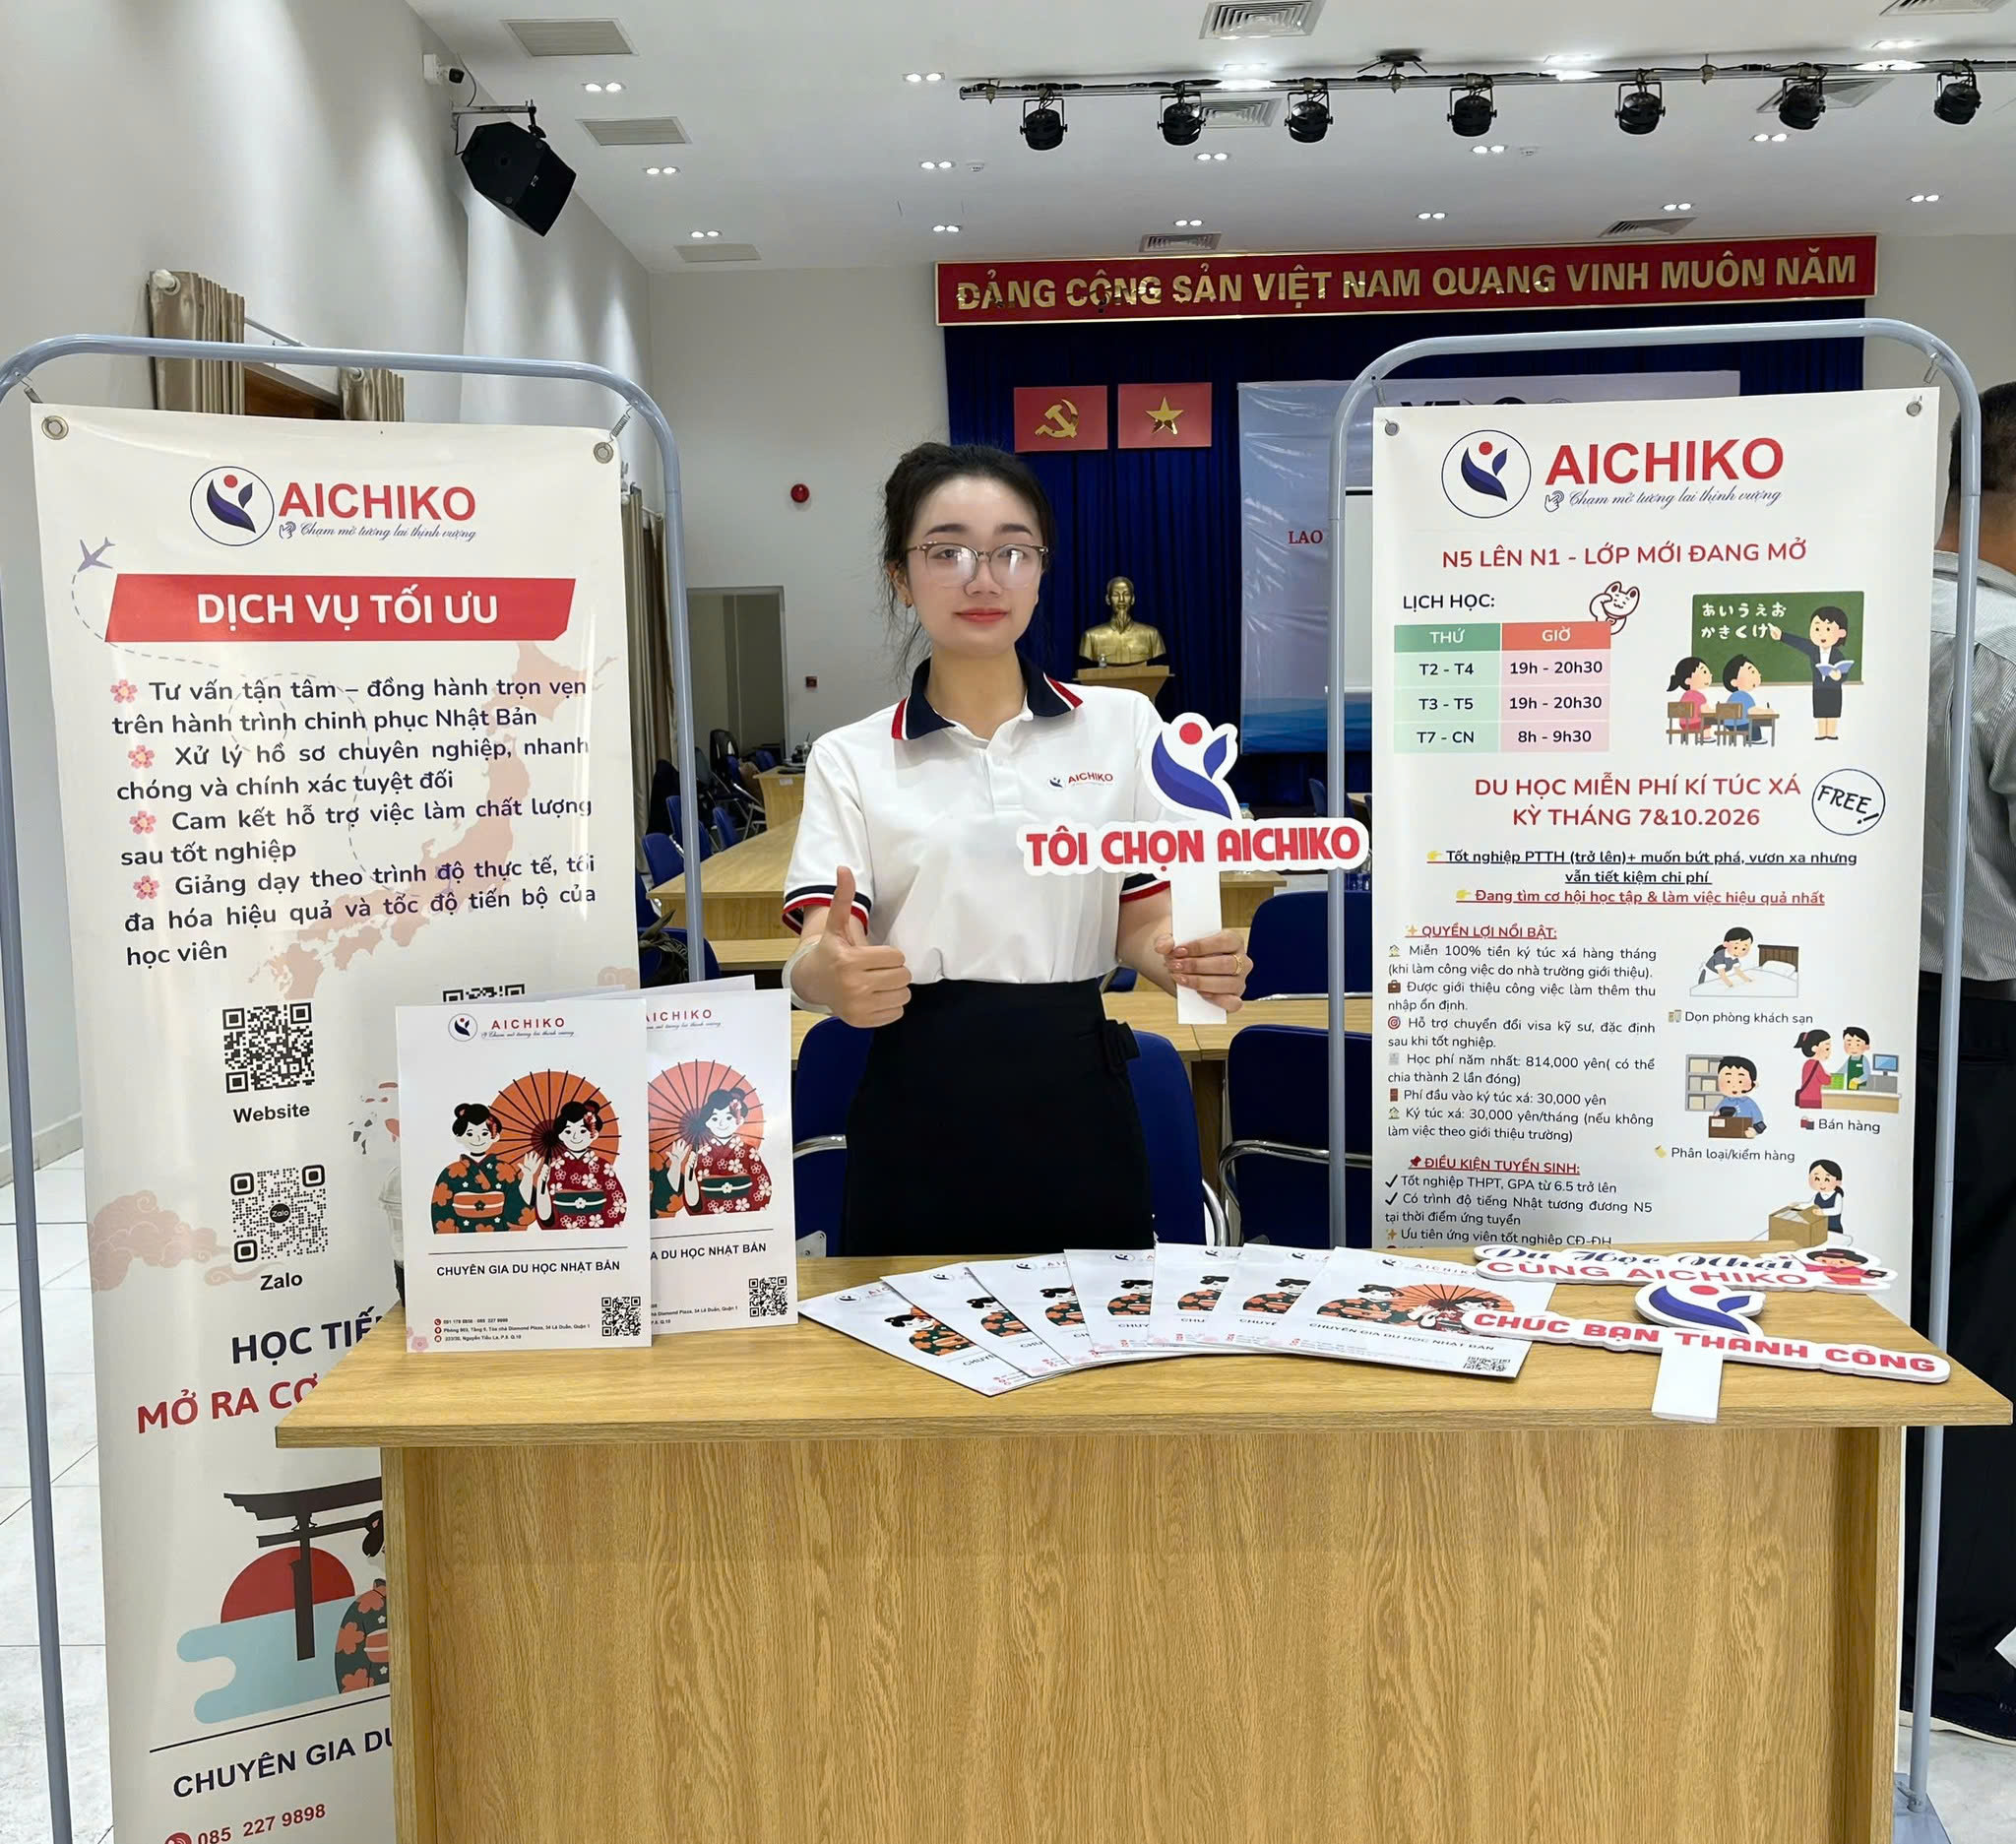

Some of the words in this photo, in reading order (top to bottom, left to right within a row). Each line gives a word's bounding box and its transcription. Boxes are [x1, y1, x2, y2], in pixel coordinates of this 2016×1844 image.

[957, 269, 1055, 310] ĐẢNG
[1066, 269, 1162, 313] CỘNG
[1172, 263, 1242, 303] SẢN
[1253, 265, 1332, 309] VIỆT
[1343, 269, 1419, 299] NAM
[1433, 264, 1555, 296] QUANG
[1567, 262, 1648, 291] VINH
[1662, 250, 1765, 288] MUÔN
[1777, 246, 1856, 286] NĂM
[1544, 437, 1784, 486] AICHIKO
[278, 481, 477, 523] AICHIKO
[1288, 530, 1324, 544] LAO
[1442, 550, 1473, 568] N5
[1480, 544, 1523, 568] LÊN
[1530, 547, 1560, 567] N1
[1585, 541, 1630, 565] LỚP
[1637, 540, 1681, 564] MỚI
[1687, 542, 1759, 563] ĐANG
[1768, 537, 1806, 561] MỞ
[197, 594, 294, 632] DỊCH
[304, 594, 359, 631] VỤ
[369, 583, 433, 624] TỐI
[444, 590, 498, 624] ƯU
[1403, 595, 1444, 613] LỊCH
[1450, 593, 1495, 611] HỌC:
[1701, 602, 1788, 618] あいうえお
[1428, 627, 1466, 644] THỨ
[1542, 625, 1571, 642] GIỜ
[1418, 663, 1439, 676] T2
[1453, 663, 1475, 675] T4
[1510, 662, 1538, 674] 19h
[1554, 661, 1603, 674] 20h30
[148, 681, 182, 701] Tư
[189, 678, 233, 701] vấn
[241, 678, 282, 704] tận
[289, 678, 337, 699] tâm
[366, 676, 424, 701] đồng
[433, 676, 488, 697] hành
[495, 678, 541, 700] trọn
[548, 681, 588, 700] vẹn
[1418, 698, 1438, 711] T3
[1453, 697, 1474, 710] T5
[1509, 696, 1538, 710] 19h
[1553, 696, 1603, 709] 20h30
[111, 713, 163, 734] trên
[172, 712, 232, 733] hành
[239, 711, 296, 731] trình
[304, 711, 366, 731] chinh
[374, 710, 429, 733] phục
[435, 707, 490, 731] Nhật
[496, 706, 537, 726] Bản
[1416, 731, 1436, 744] T7
[1452, 731, 1475, 743] CN
[1517, 731, 1537, 743] 8h
[1552, 730, 1592, 743] 9h30
[116, 779, 192, 802] chóng
[200, 776, 228, 797] và
[235, 775, 299, 796] chính
[307, 773, 347, 794] xác
[351, 771, 413, 795] tuyệt
[419, 768, 453, 790] đối
[1068, 772, 1113, 784] AICHIKO
[1475, 779, 1508, 796] DU
[1516, 778, 1567, 800] HỌC
[1574, 773, 1630, 795] MIỄN
[1638, 773, 1679, 795] PHÍ
[1685, 773, 1708, 795] KÍ
[1712, 773, 1761, 795] TÚC
[1768, 773, 1801, 795] XÁ
[1513, 803, 1542, 826] KỲ
[1546, 803, 1631, 826] THÁNG
[1638, 808, 1760, 826] 7&10.2026
[120, 850, 163, 866] sau
[169, 841, 209, 863] tốt
[215, 838, 296, 864] nghiệp
[1027, 825, 1088, 866] TÔI
[1101, 830, 1205, 872] CHỌN
[1218, 826, 1360, 862] AICHIKO
[1565, 869, 1591, 883] vẫn
[1595, 869, 1619, 883] tiết
[1623, 870, 1657, 885] kiệm
[1662, 871, 1681, 883] chi
[1685, 870, 1709, 885] phí
[1421, 922, 1469, 937] QUYỀN
[1473, 924, 1494, 937] LỢI
[1498, 922, 1523, 937] NỔI
[1527, 923, 1557, 939] BẬT:
[126, 946, 170, 970] học
[176, 939, 227, 962] viên
[491, 1017, 565, 1031] AICHIKO
[1684, 1011, 1710, 1022] Dọn
[1713, 1011, 1750, 1025] phòng
[1753, 1012, 1789, 1024] khách
[1792, 1015, 1813, 1024] sạn
[1407, 1053, 1430, 1064] Học
[1435, 1052, 1455, 1066] phí
[1459, 1053, 1485, 1065] năm
[1490, 1054, 1521, 1067] nhất:
[1614, 1057, 1630, 1070] có
[1634, 1057, 1656, 1070] thể
[232, 1103, 310, 1123] Website
[1818, 1118, 1844, 1130] Bán
[1848, 1119, 1881, 1135] hàng
[1423, 1154, 1457, 1169] ĐIỀU
[1460, 1156, 1490, 1170] KIỆN
[1493, 1157, 1540, 1173] TUYỂN
[1544, 1162, 1580, 1174] SINH:
[1670, 1147, 1703, 1159] Phân
[1706, 1148, 1761, 1161] loại/kiểm
[1764, 1149, 1796, 1164] hàng
[271, 1208, 289, 1219] Zalo
[436, 1263, 485, 1277] CHUYÊN
[488, 1264, 510, 1275] GIA
[512, 1263, 529, 1274] DU
[532, 1262, 557, 1275] HỌC
[560, 1261, 593, 1272] NHẬT
[595, 1259, 620, 1271] BẢN
[1487, 1260, 1610, 1278] CÙNG
[1626, 1267, 1807, 1285] AICHIKO
[260, 1272, 303, 1292] Zalo
[231, 1326, 312, 1366] HỌC
[321, 1305, 383, 1350] TIẾ
[1474, 1313, 1570, 1333] CHÚC
[1583, 1322, 1660, 1342] BẠN
[1674, 1332, 1808, 1359] THÀNH
[1825, 1348, 1936, 1372] CÔNG
[137, 1388, 199, 1434] MỞ
[211, 1387, 260, 1420] RA
[173, 1750, 296, 1798] CHUYÊN
[305, 1738, 356, 1766] GIA
[197, 1826, 231, 1844] 085
[242, 1815, 276, 1837] 227
[282, 1804, 326, 1827] 9898
